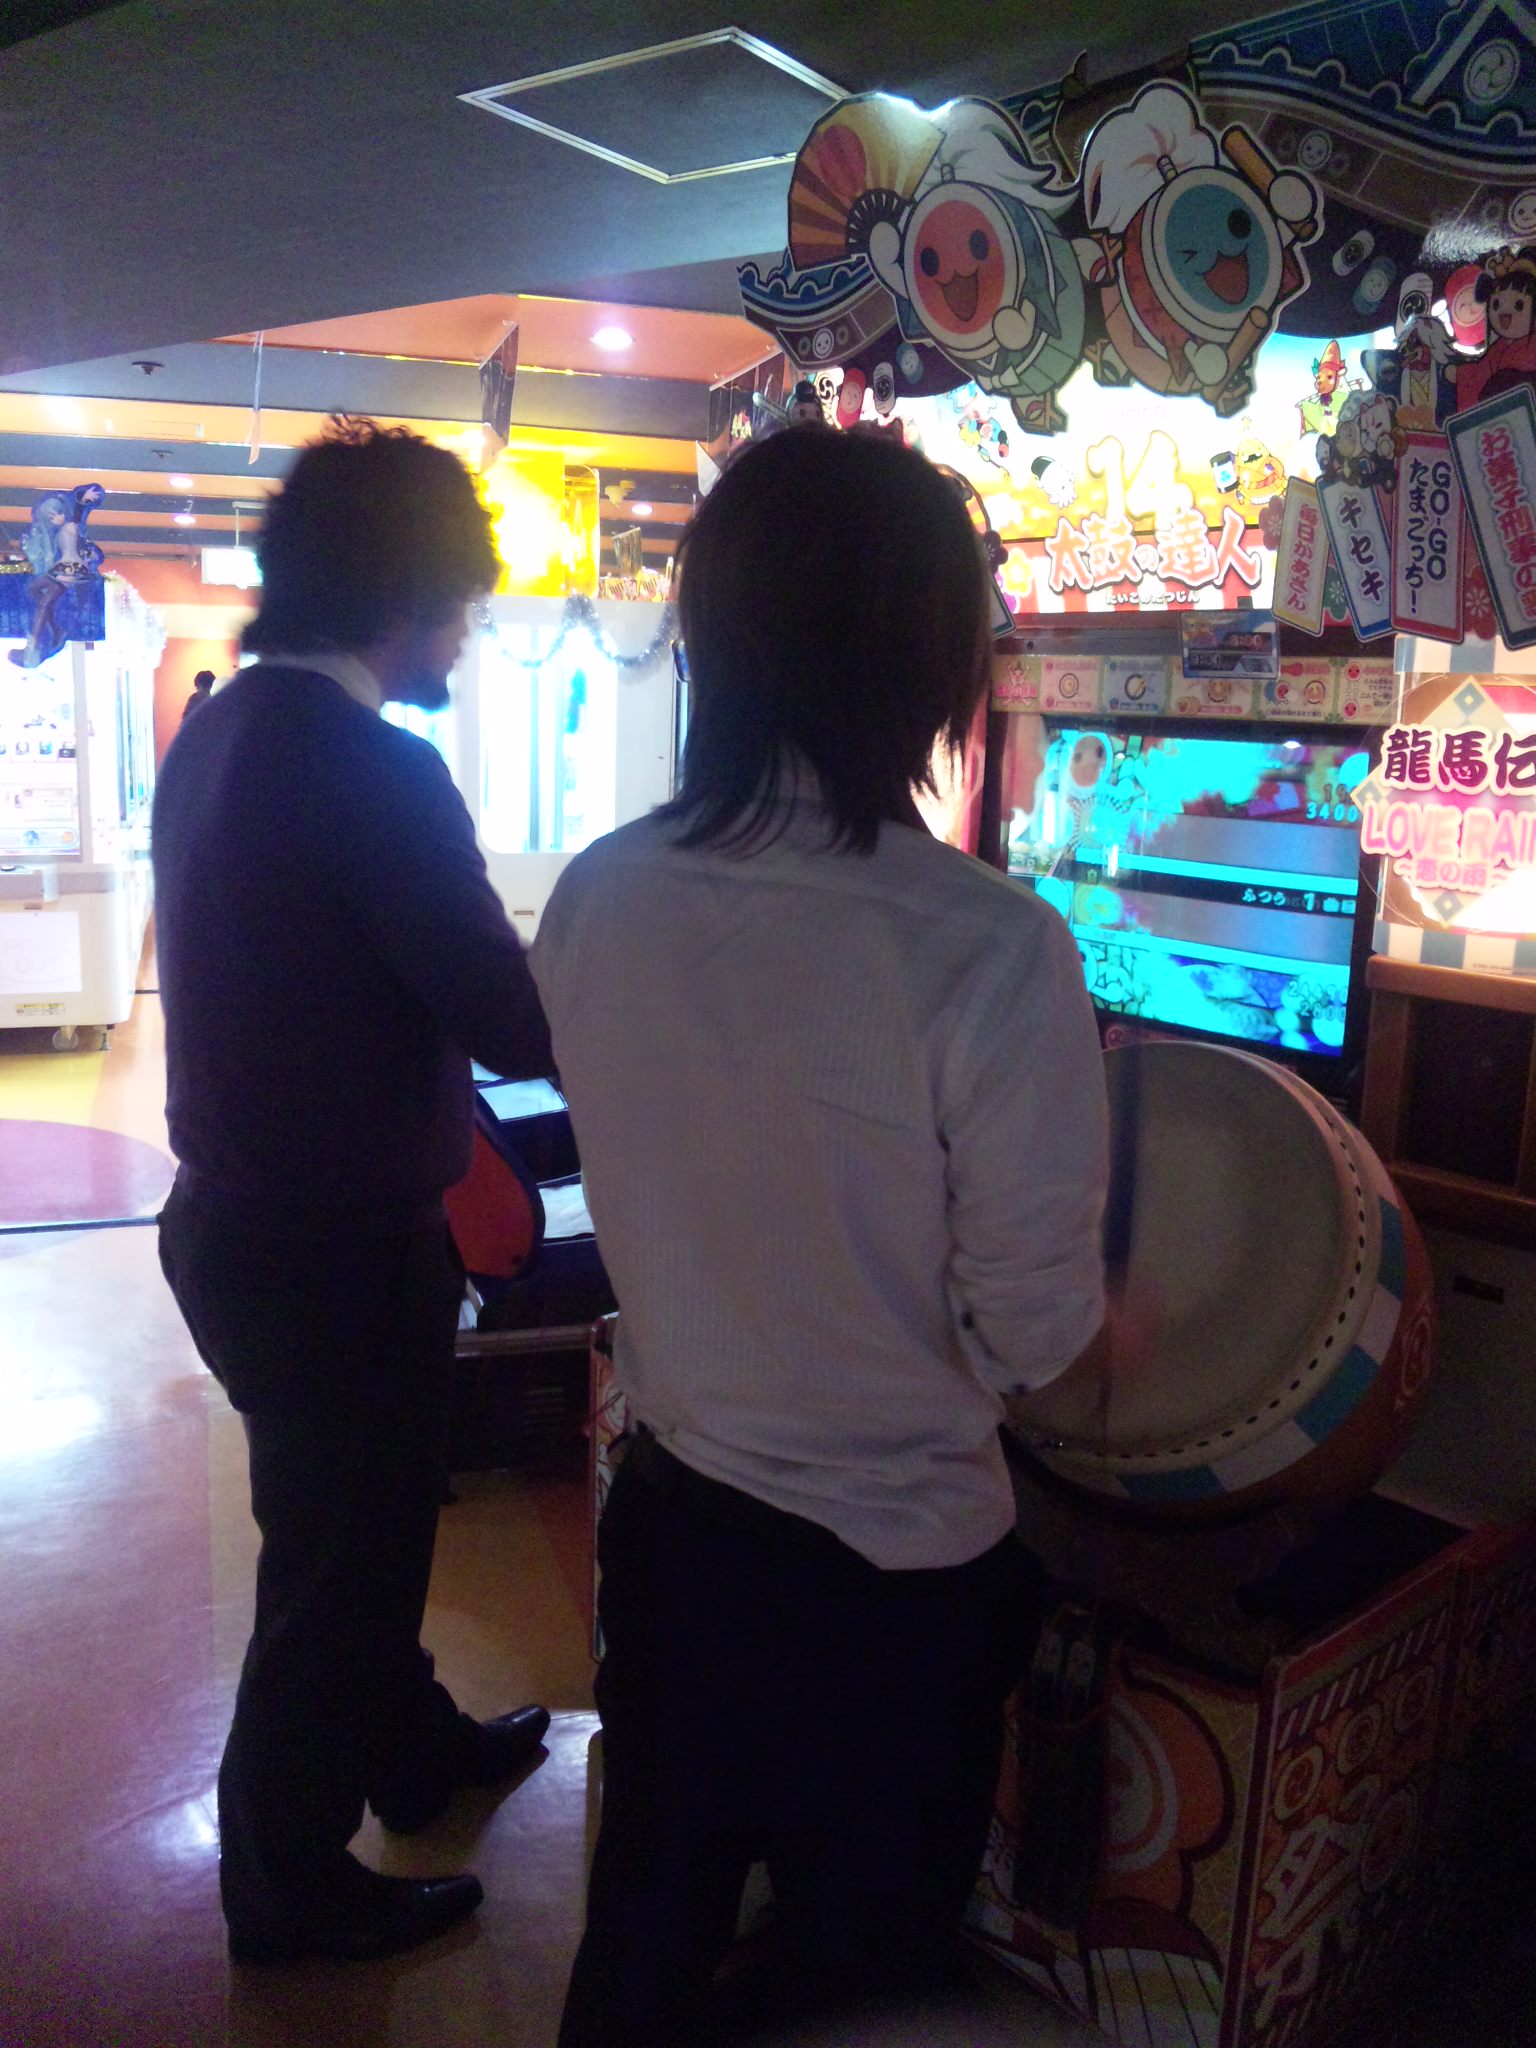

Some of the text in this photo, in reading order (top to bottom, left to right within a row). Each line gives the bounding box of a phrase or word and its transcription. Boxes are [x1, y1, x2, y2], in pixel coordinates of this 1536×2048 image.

[1086, 430, 1195, 531] 14
[1426, 461, 1452, 581] GO-GO
[1046, 507, 1261, 591] 太鼓の達人
[1340, 497, 1384, 601] キセキ
[1384, 728, 1536, 789] 龍馬伝
[1366, 805, 1459, 856] LOVE
